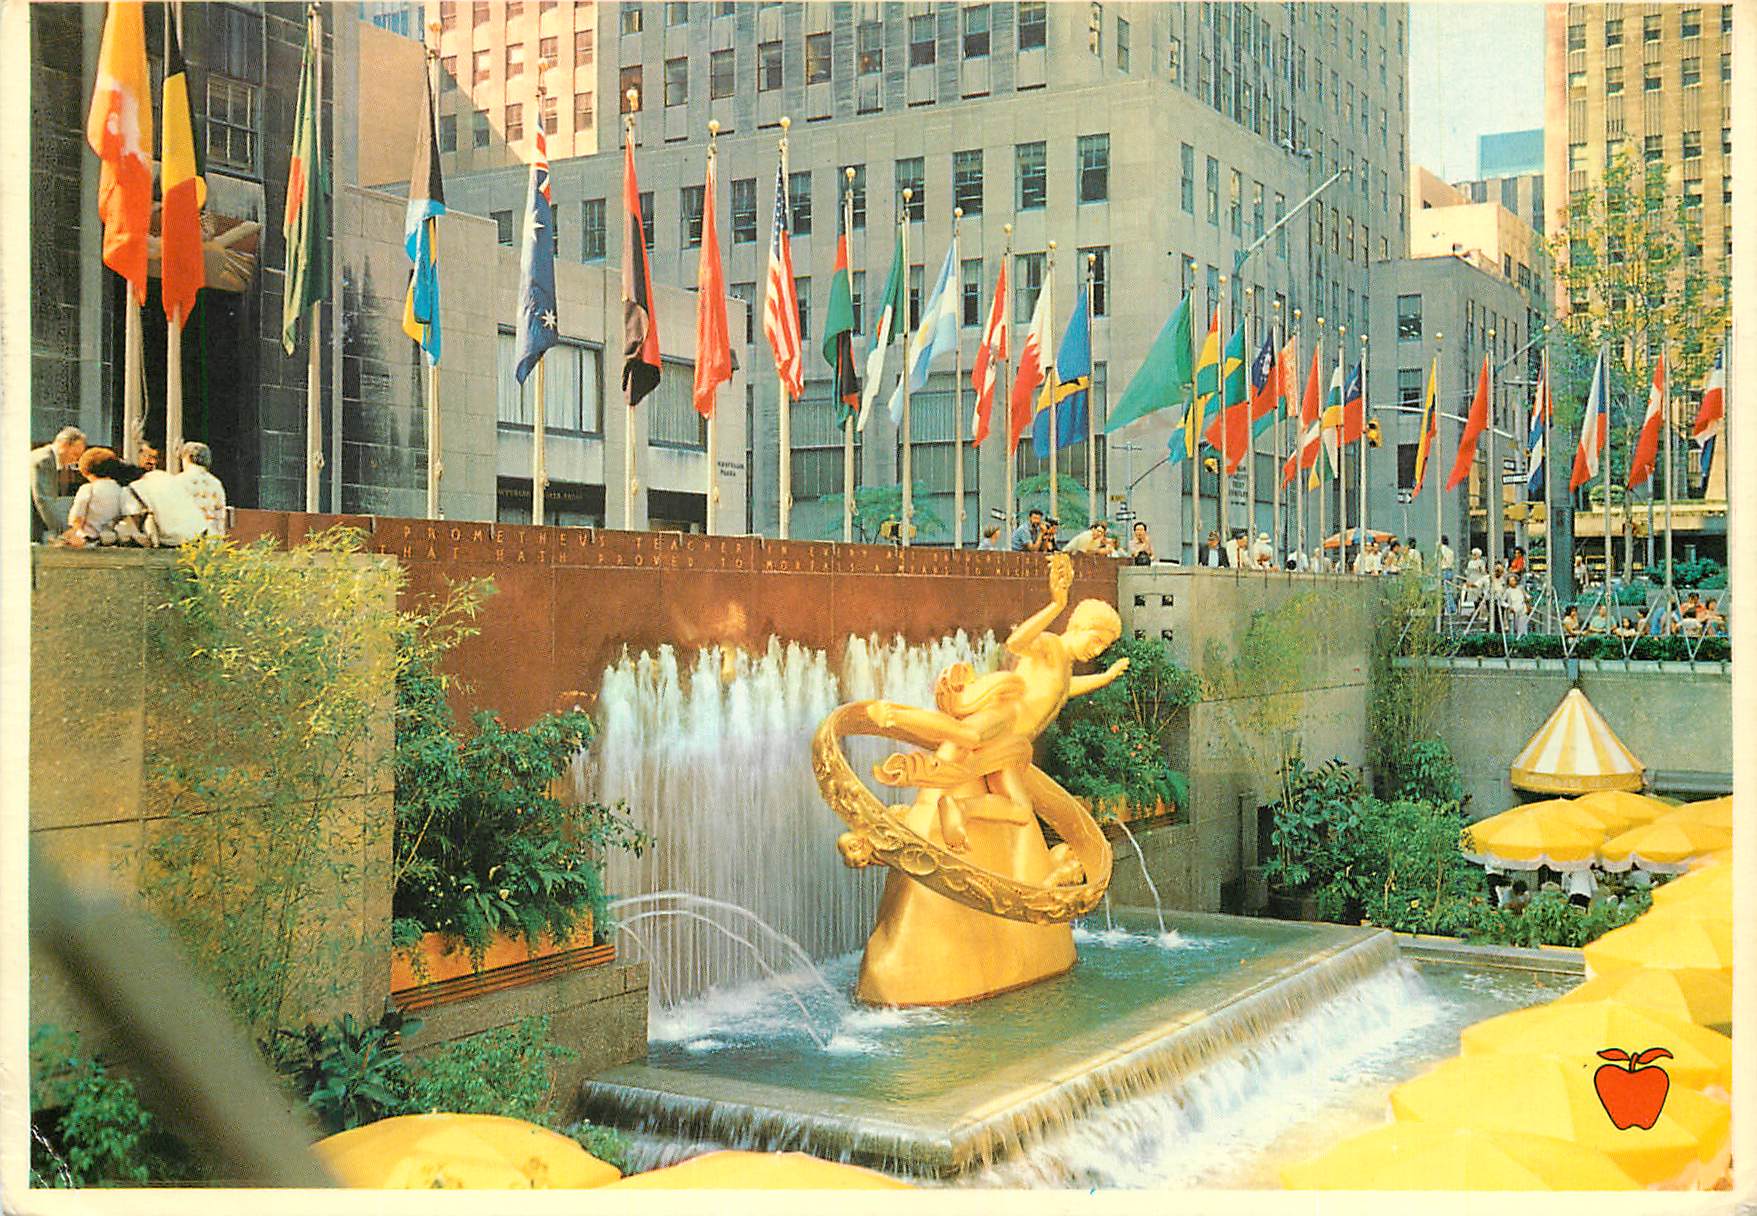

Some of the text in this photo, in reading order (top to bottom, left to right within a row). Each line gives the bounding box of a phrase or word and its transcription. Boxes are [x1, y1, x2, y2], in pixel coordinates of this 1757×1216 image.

[635, 537, 743, 553] TEACHER
[379, 544, 460, 561] THAT
[496, 549, 567, 563] HATH
[598, 553, 694, 568] PROVED
[720, 557, 744, 569] TO
